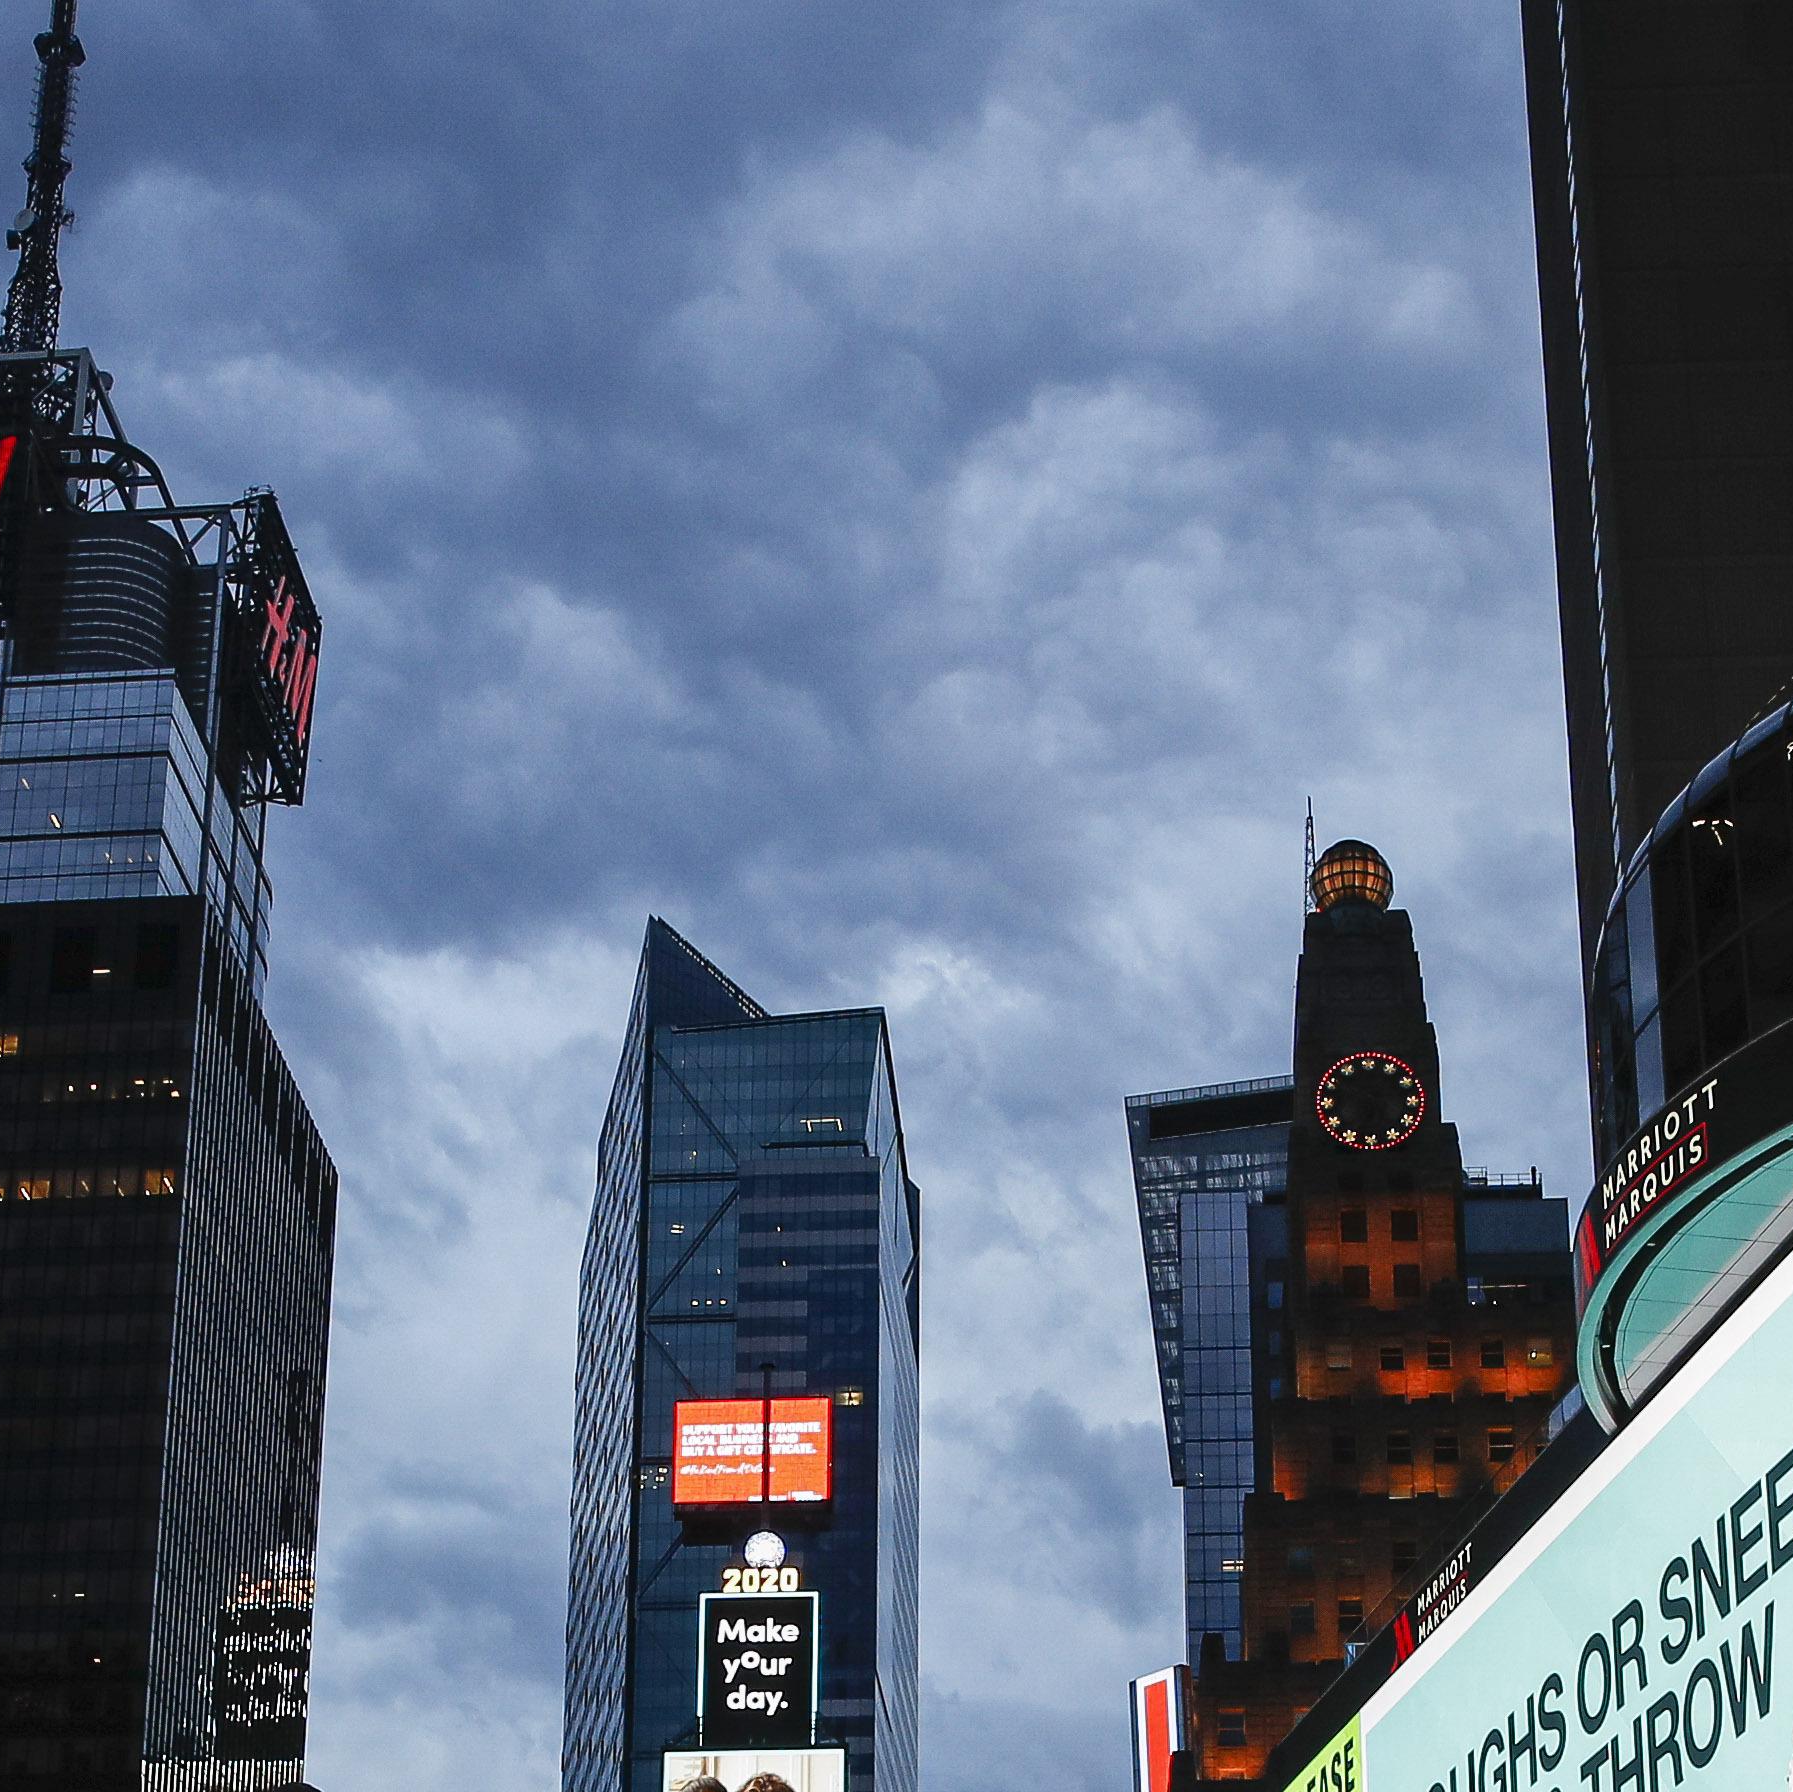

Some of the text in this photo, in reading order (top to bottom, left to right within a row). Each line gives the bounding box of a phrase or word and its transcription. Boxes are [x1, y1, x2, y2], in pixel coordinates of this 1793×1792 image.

[262, 577, 317, 741] H&M
[1602, 1079, 1718, 1210] MARRIOTT
[1604, 1134, 1702, 1249] MARQUIS
[722, 1567, 800, 1594] 2020
[1417, 1542, 1472, 1616] MARRIOTT
[1418, 1578, 1467, 1644] MARQUIS
[717, 1618, 800, 1645] Make
[1576, 1597, 1649, 1735] OR
[723, 1650, 793, 1686] your
[726, 1684, 788, 1716] day.
